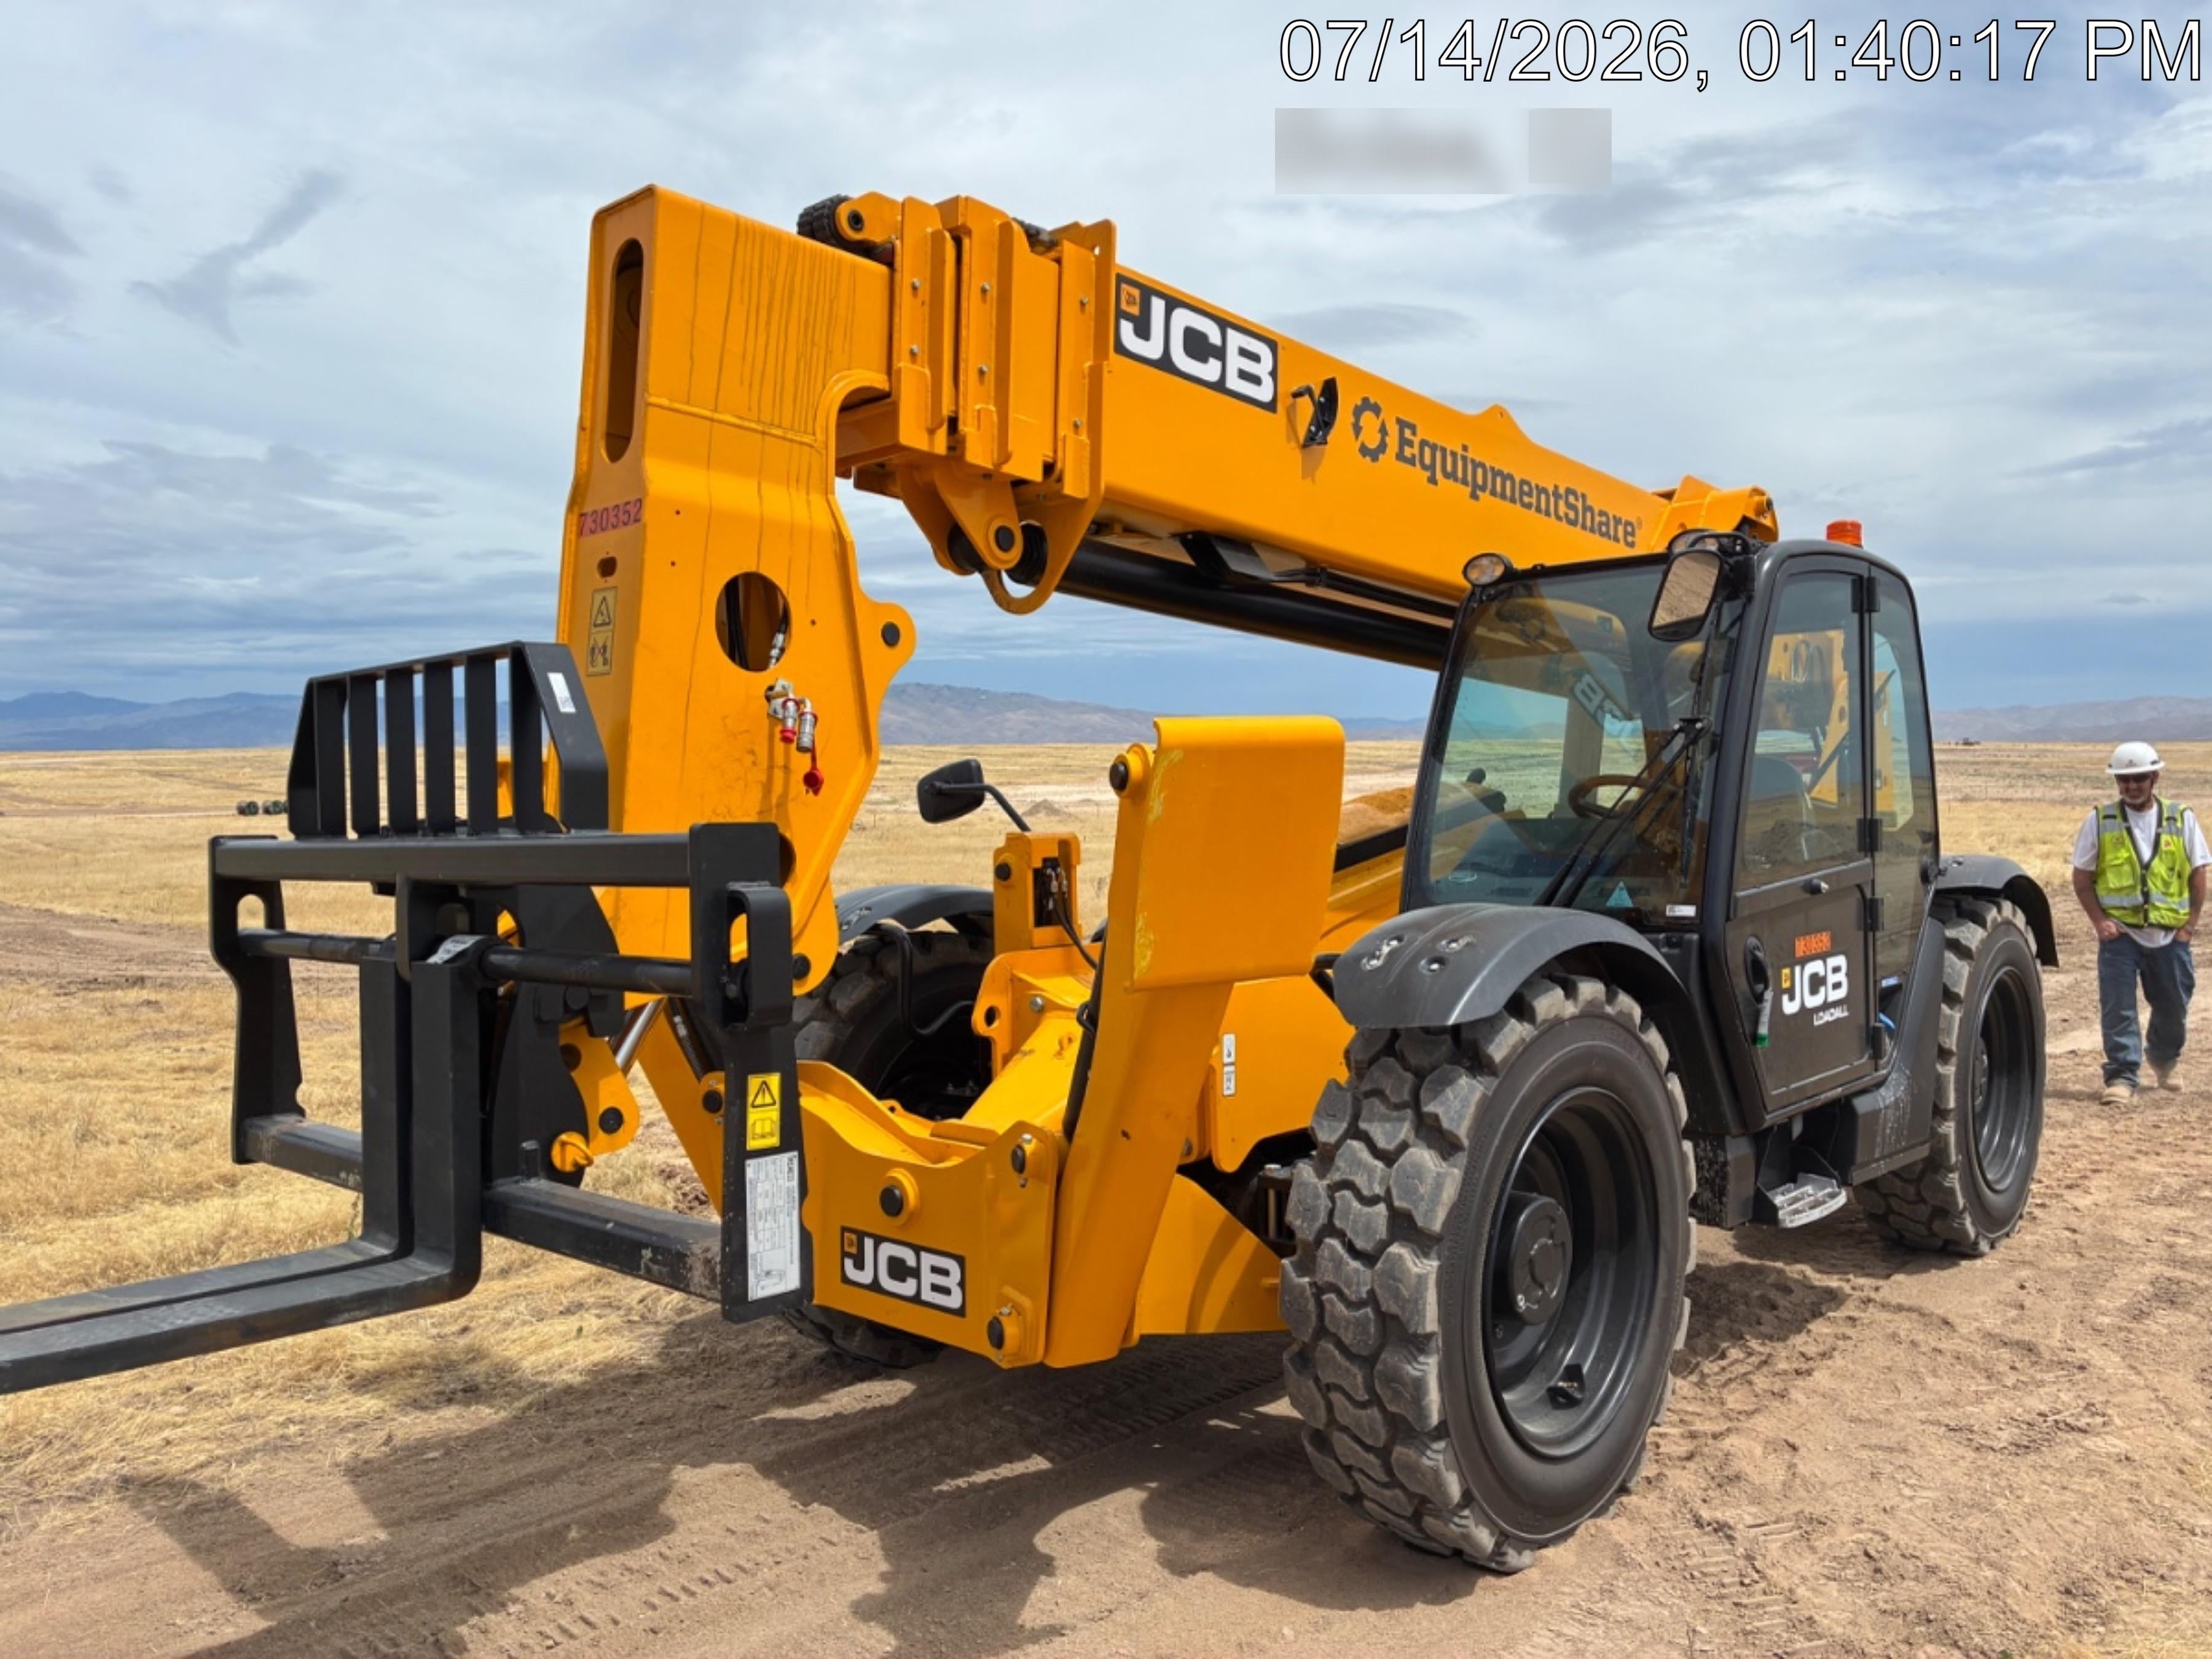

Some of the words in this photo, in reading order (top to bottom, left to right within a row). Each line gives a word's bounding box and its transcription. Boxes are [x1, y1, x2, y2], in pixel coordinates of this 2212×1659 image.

[1119, 295, 1274, 404] JCB
[579, 497, 642, 536] 730352
[1395, 417, 1636, 549] EquipmentShare
[1782, 954, 1848, 1015] JCB
[844, 1236, 963, 1310] JCB
